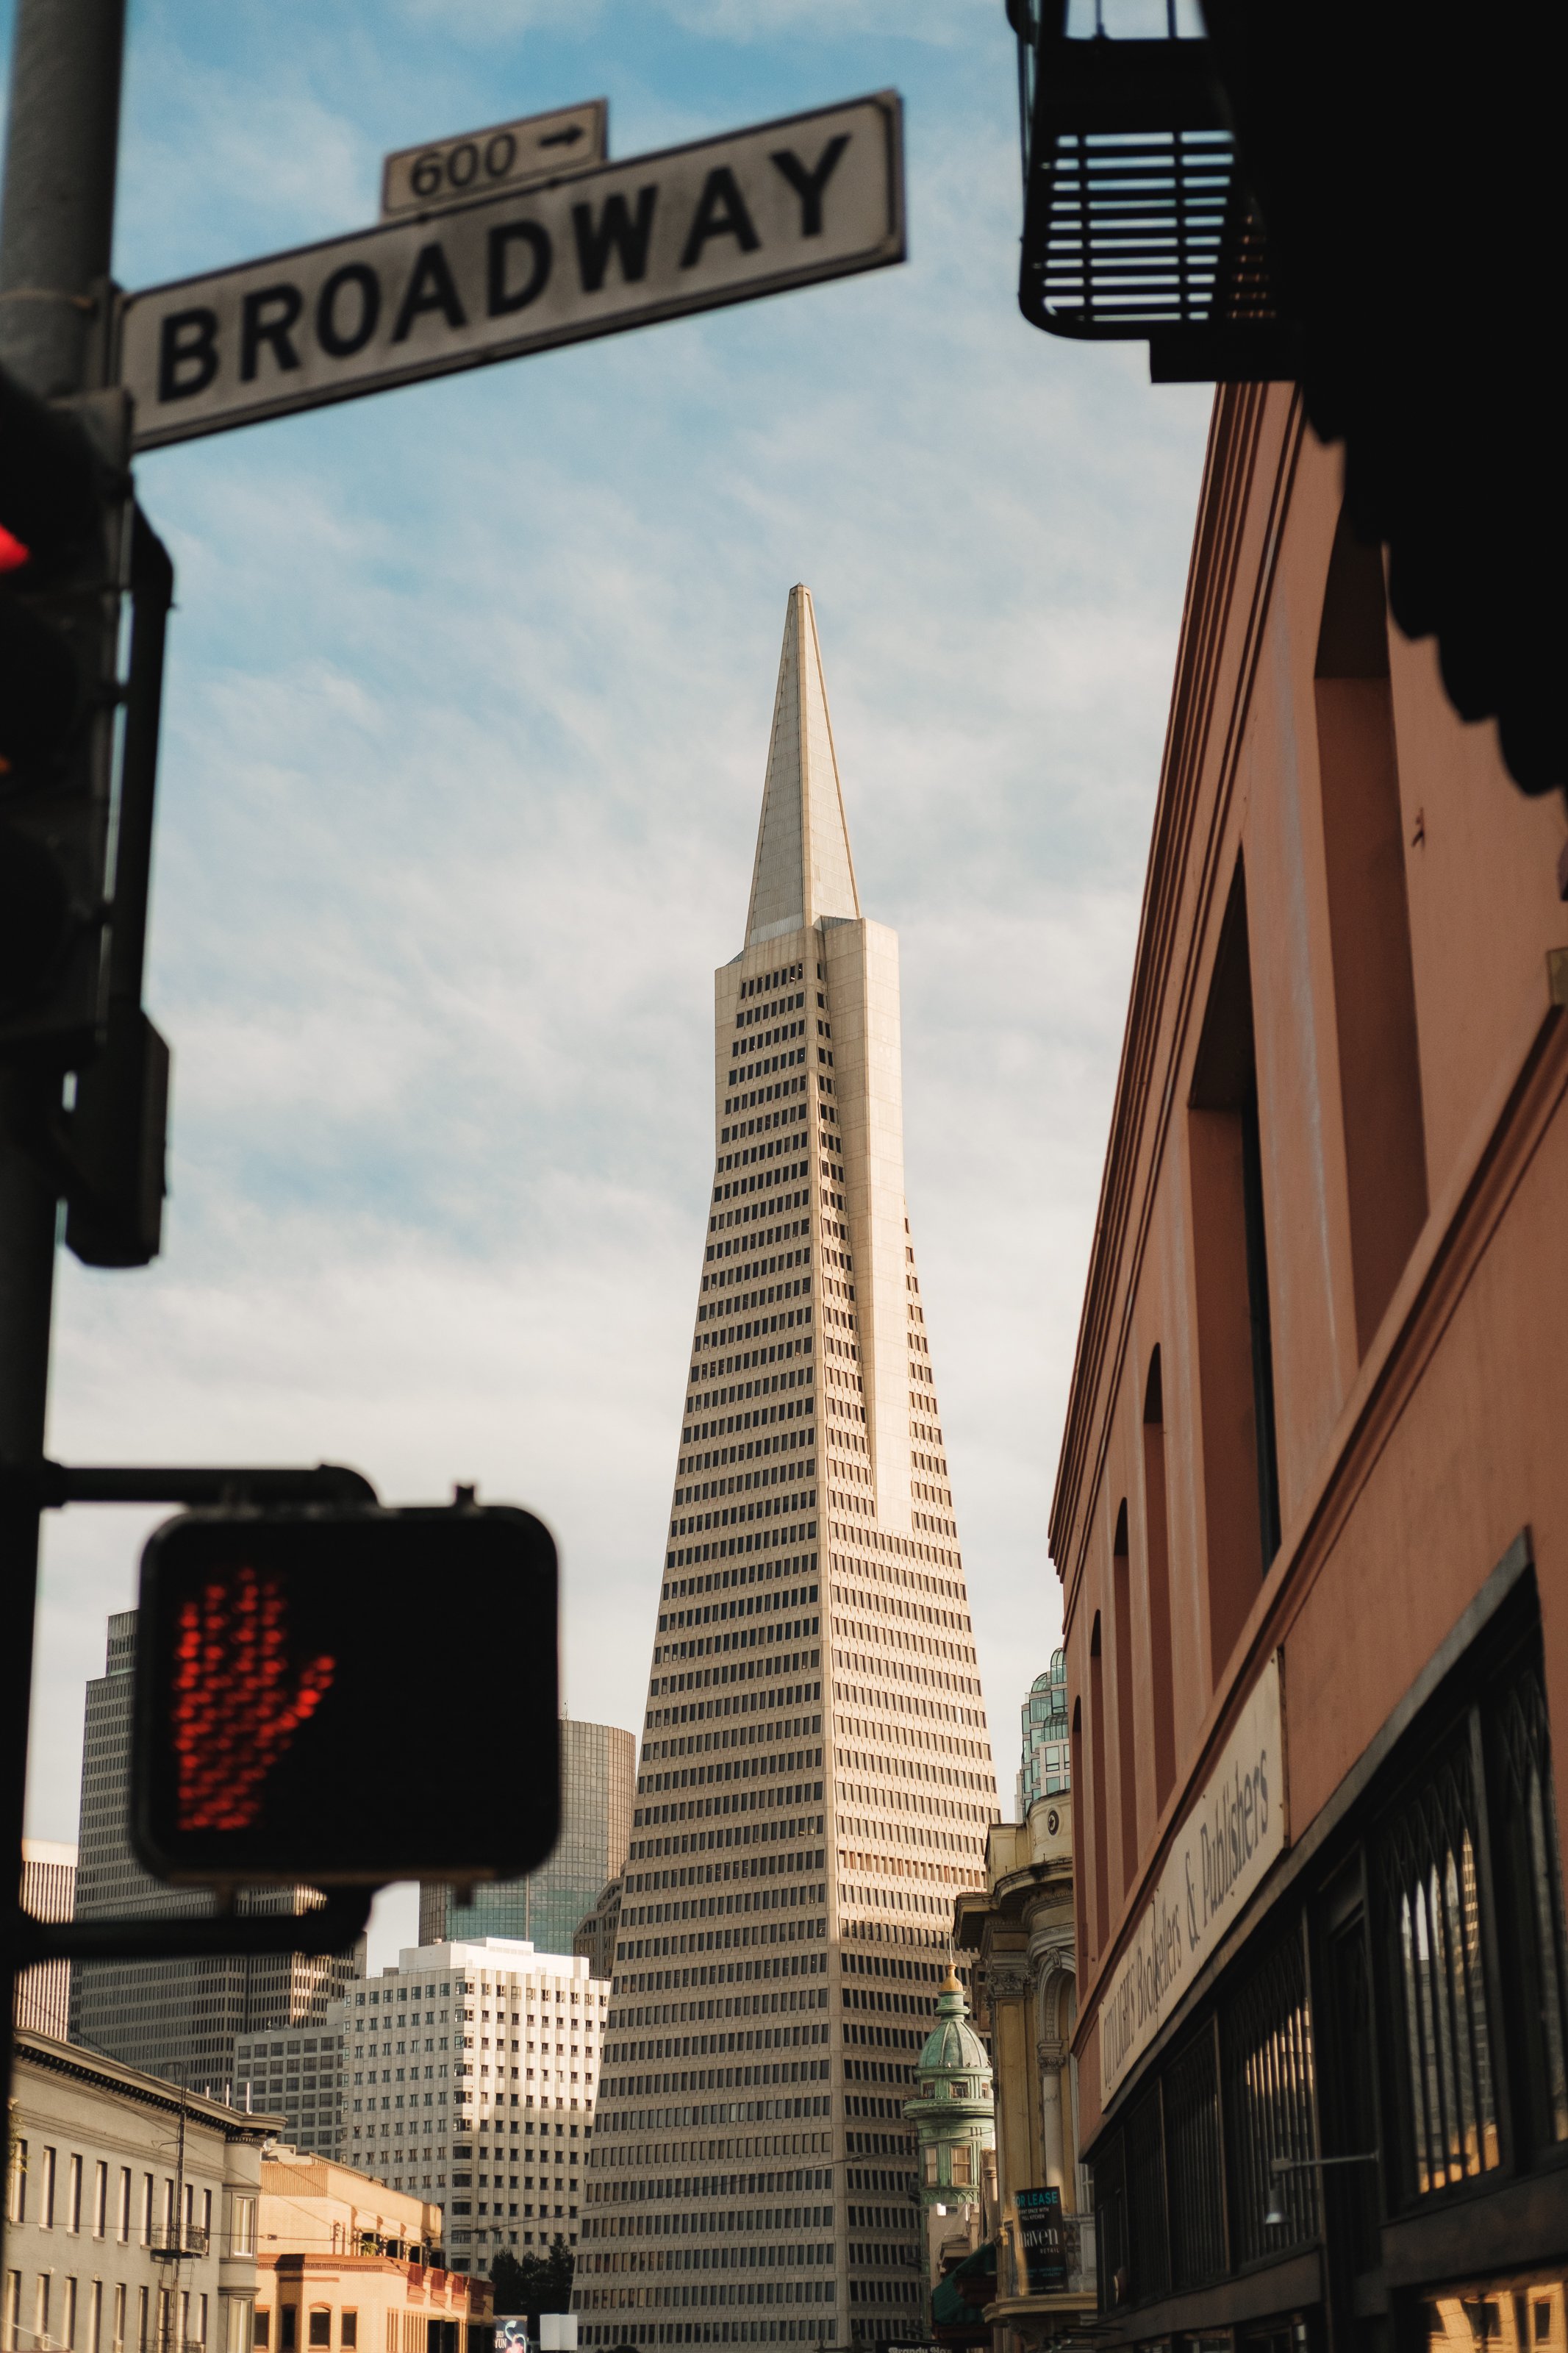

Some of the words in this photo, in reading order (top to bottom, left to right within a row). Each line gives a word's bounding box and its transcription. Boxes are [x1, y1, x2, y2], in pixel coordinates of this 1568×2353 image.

[409, 130, 518, 199] 600
[157, 134, 853, 404] BROADWAY
[1200, 1749, 1268, 1928] Publishers
[1029, 2191, 1058, 2206] LEASE
[1017, 2229, 1059, 2248] maven
[495, 2338, 506, 2349] YUN
